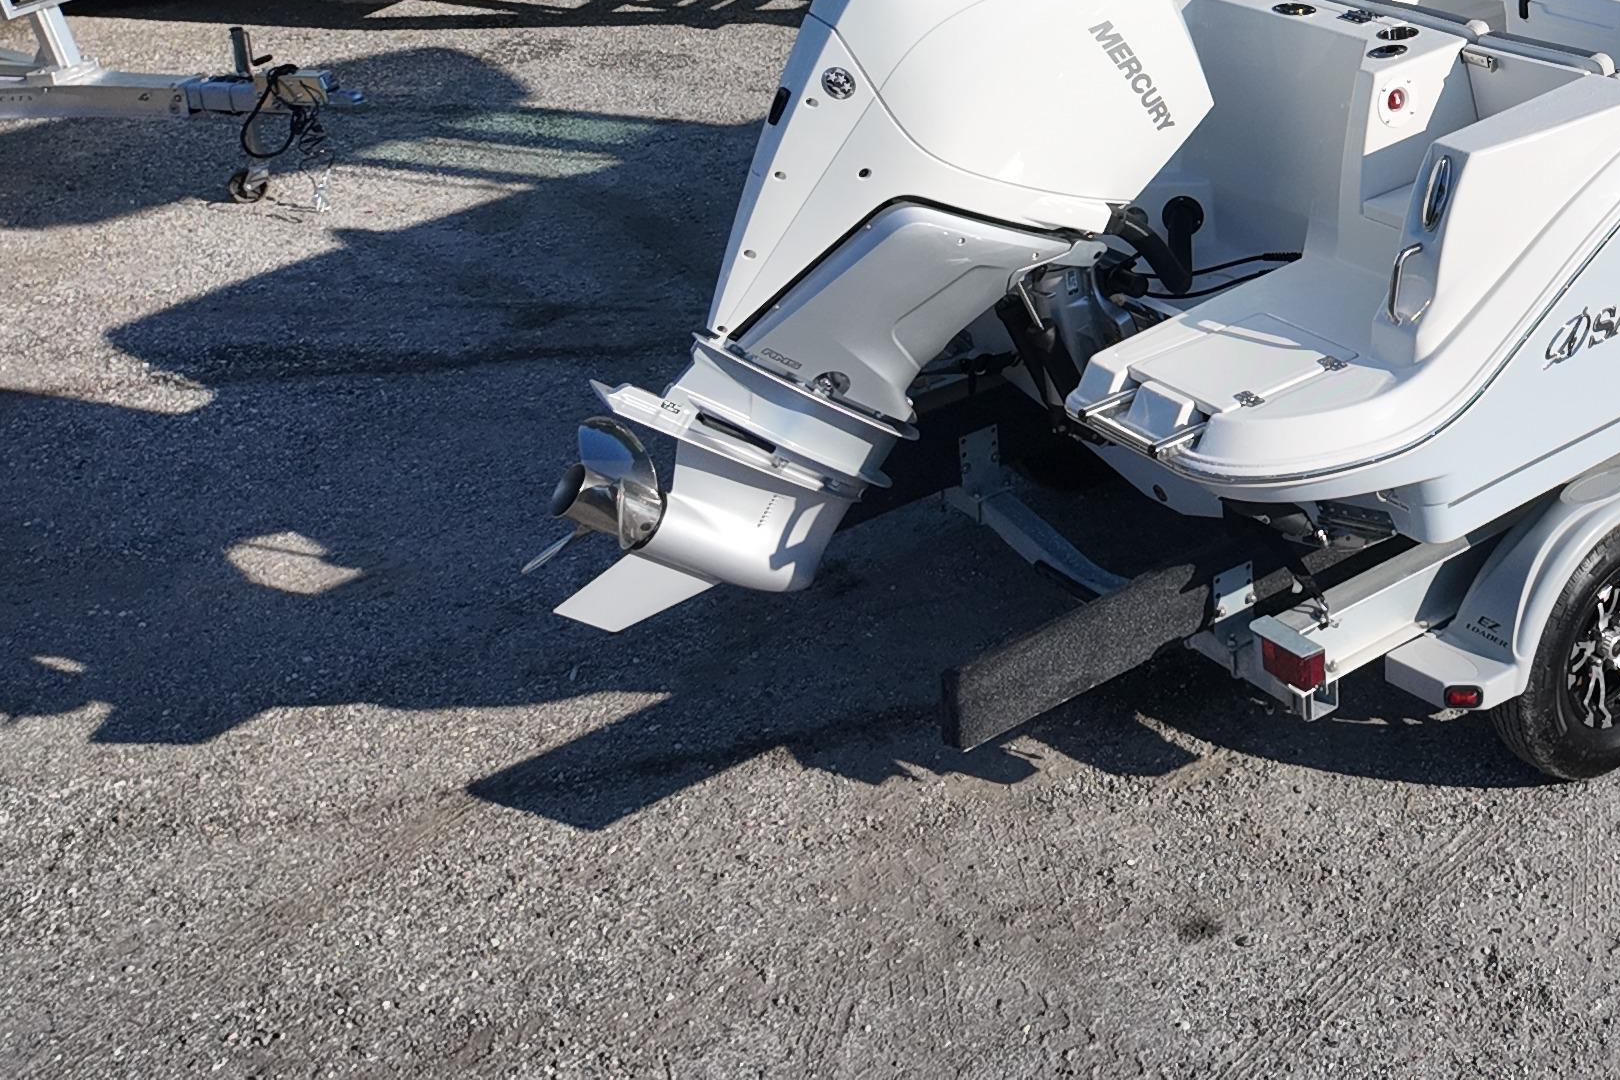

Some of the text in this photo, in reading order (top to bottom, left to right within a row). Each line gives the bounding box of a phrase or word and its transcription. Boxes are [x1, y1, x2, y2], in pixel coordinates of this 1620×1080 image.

[1087, 20, 1175, 131] MERCURY
[1465, 623, 1509, 649] LOADER
[1477, 615, 1502, 633] EZ
